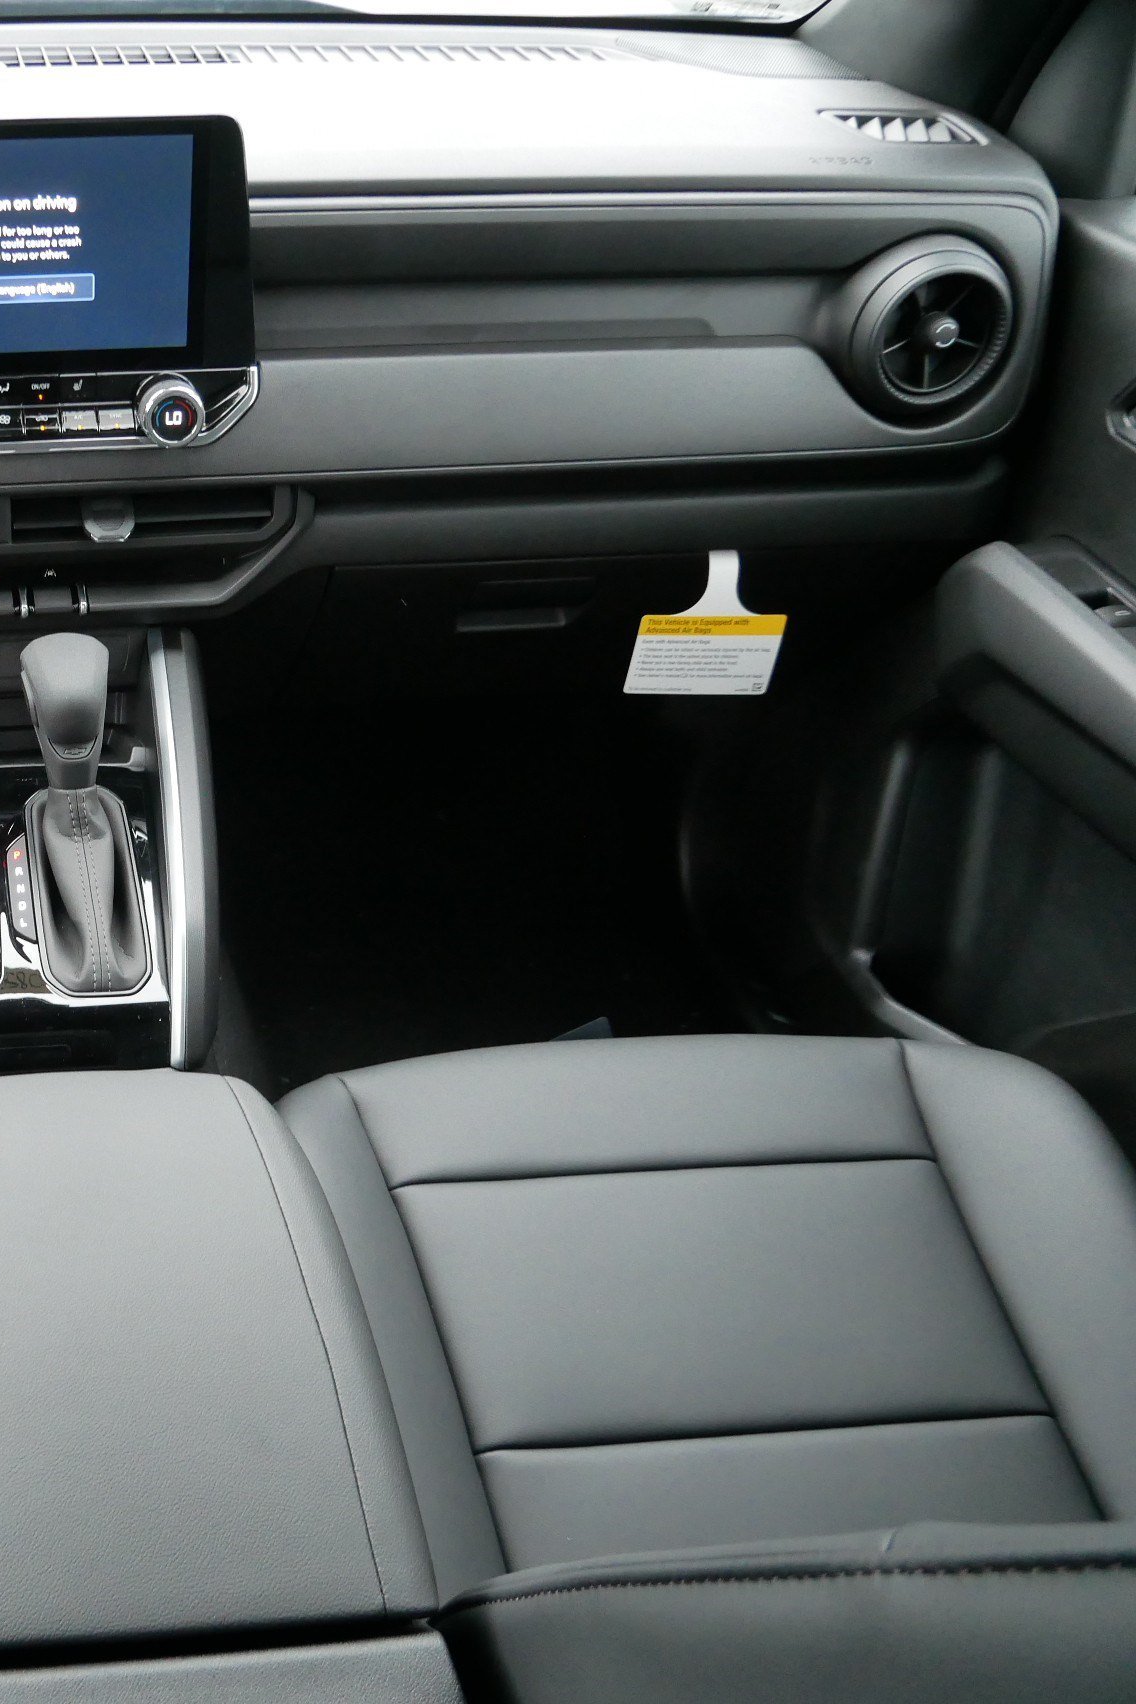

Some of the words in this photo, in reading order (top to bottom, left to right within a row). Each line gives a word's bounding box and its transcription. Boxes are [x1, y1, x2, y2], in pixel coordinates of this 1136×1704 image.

[13, 199, 31, 211] on
[32, 194, 77, 213] driving
[2, 225, 16, 237] for
[16, 226, 32, 236] too
[32, 225, 52, 238] long
[53, 226, 63, 235] or
[64, 225, 80, 235] too
[1, 237, 24, 250] could
[25, 239, 50, 249] cause
[58, 236, 82, 247] crash
[1, 251, 11, 261] to
[11, 252, 28, 264] you
[28, 251, 39, 260] or
[664, 618, 691, 626] Vehicle
[699, 618, 732, 628] Equipped
[733, 618, 750, 626] with
[645, 626, 681, 635] Advanced
[694, 626, 712, 635] Bags
[13, 850, 21, 860] P
[15, 866, 24, 877] R
[16, 883, 25, 894] N
[18, 900, 27, 911] D
[19, 917, 28, 928] L
